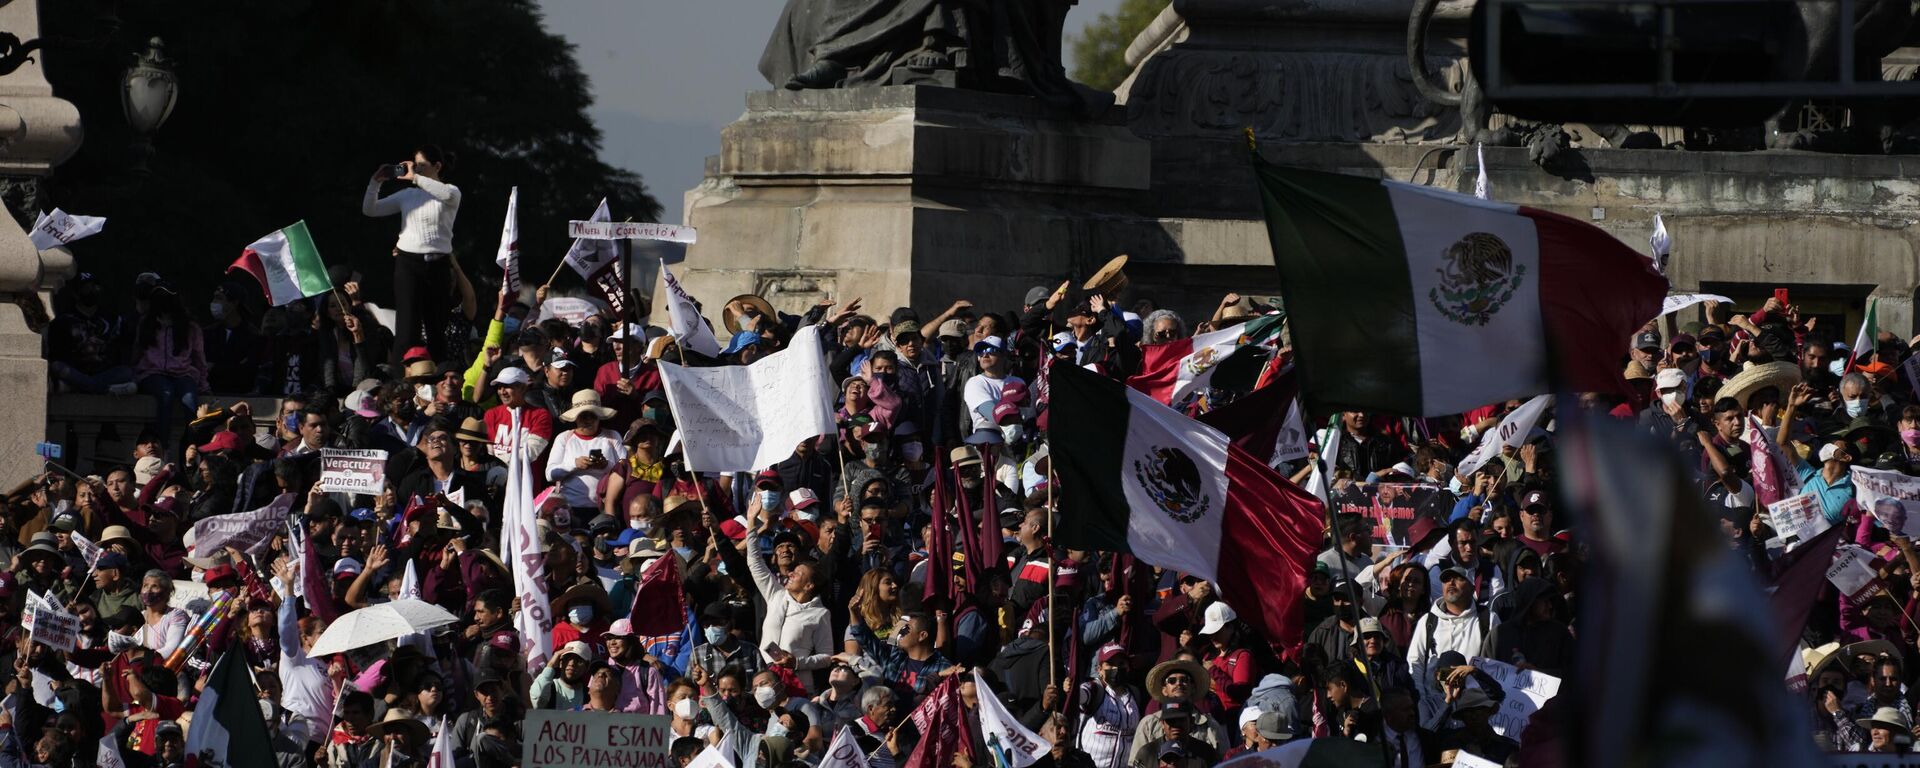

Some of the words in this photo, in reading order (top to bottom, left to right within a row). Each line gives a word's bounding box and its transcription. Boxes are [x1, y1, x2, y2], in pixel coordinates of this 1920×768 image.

[325, 449, 378, 458] MINATITLAN
[326, 458, 371, 470] Veracruz
[323, 476, 368, 487] morena
[538, 720, 586, 744] AQUI
[607, 725, 664, 748] ESTAN
[531, 743, 566, 764] LOS
